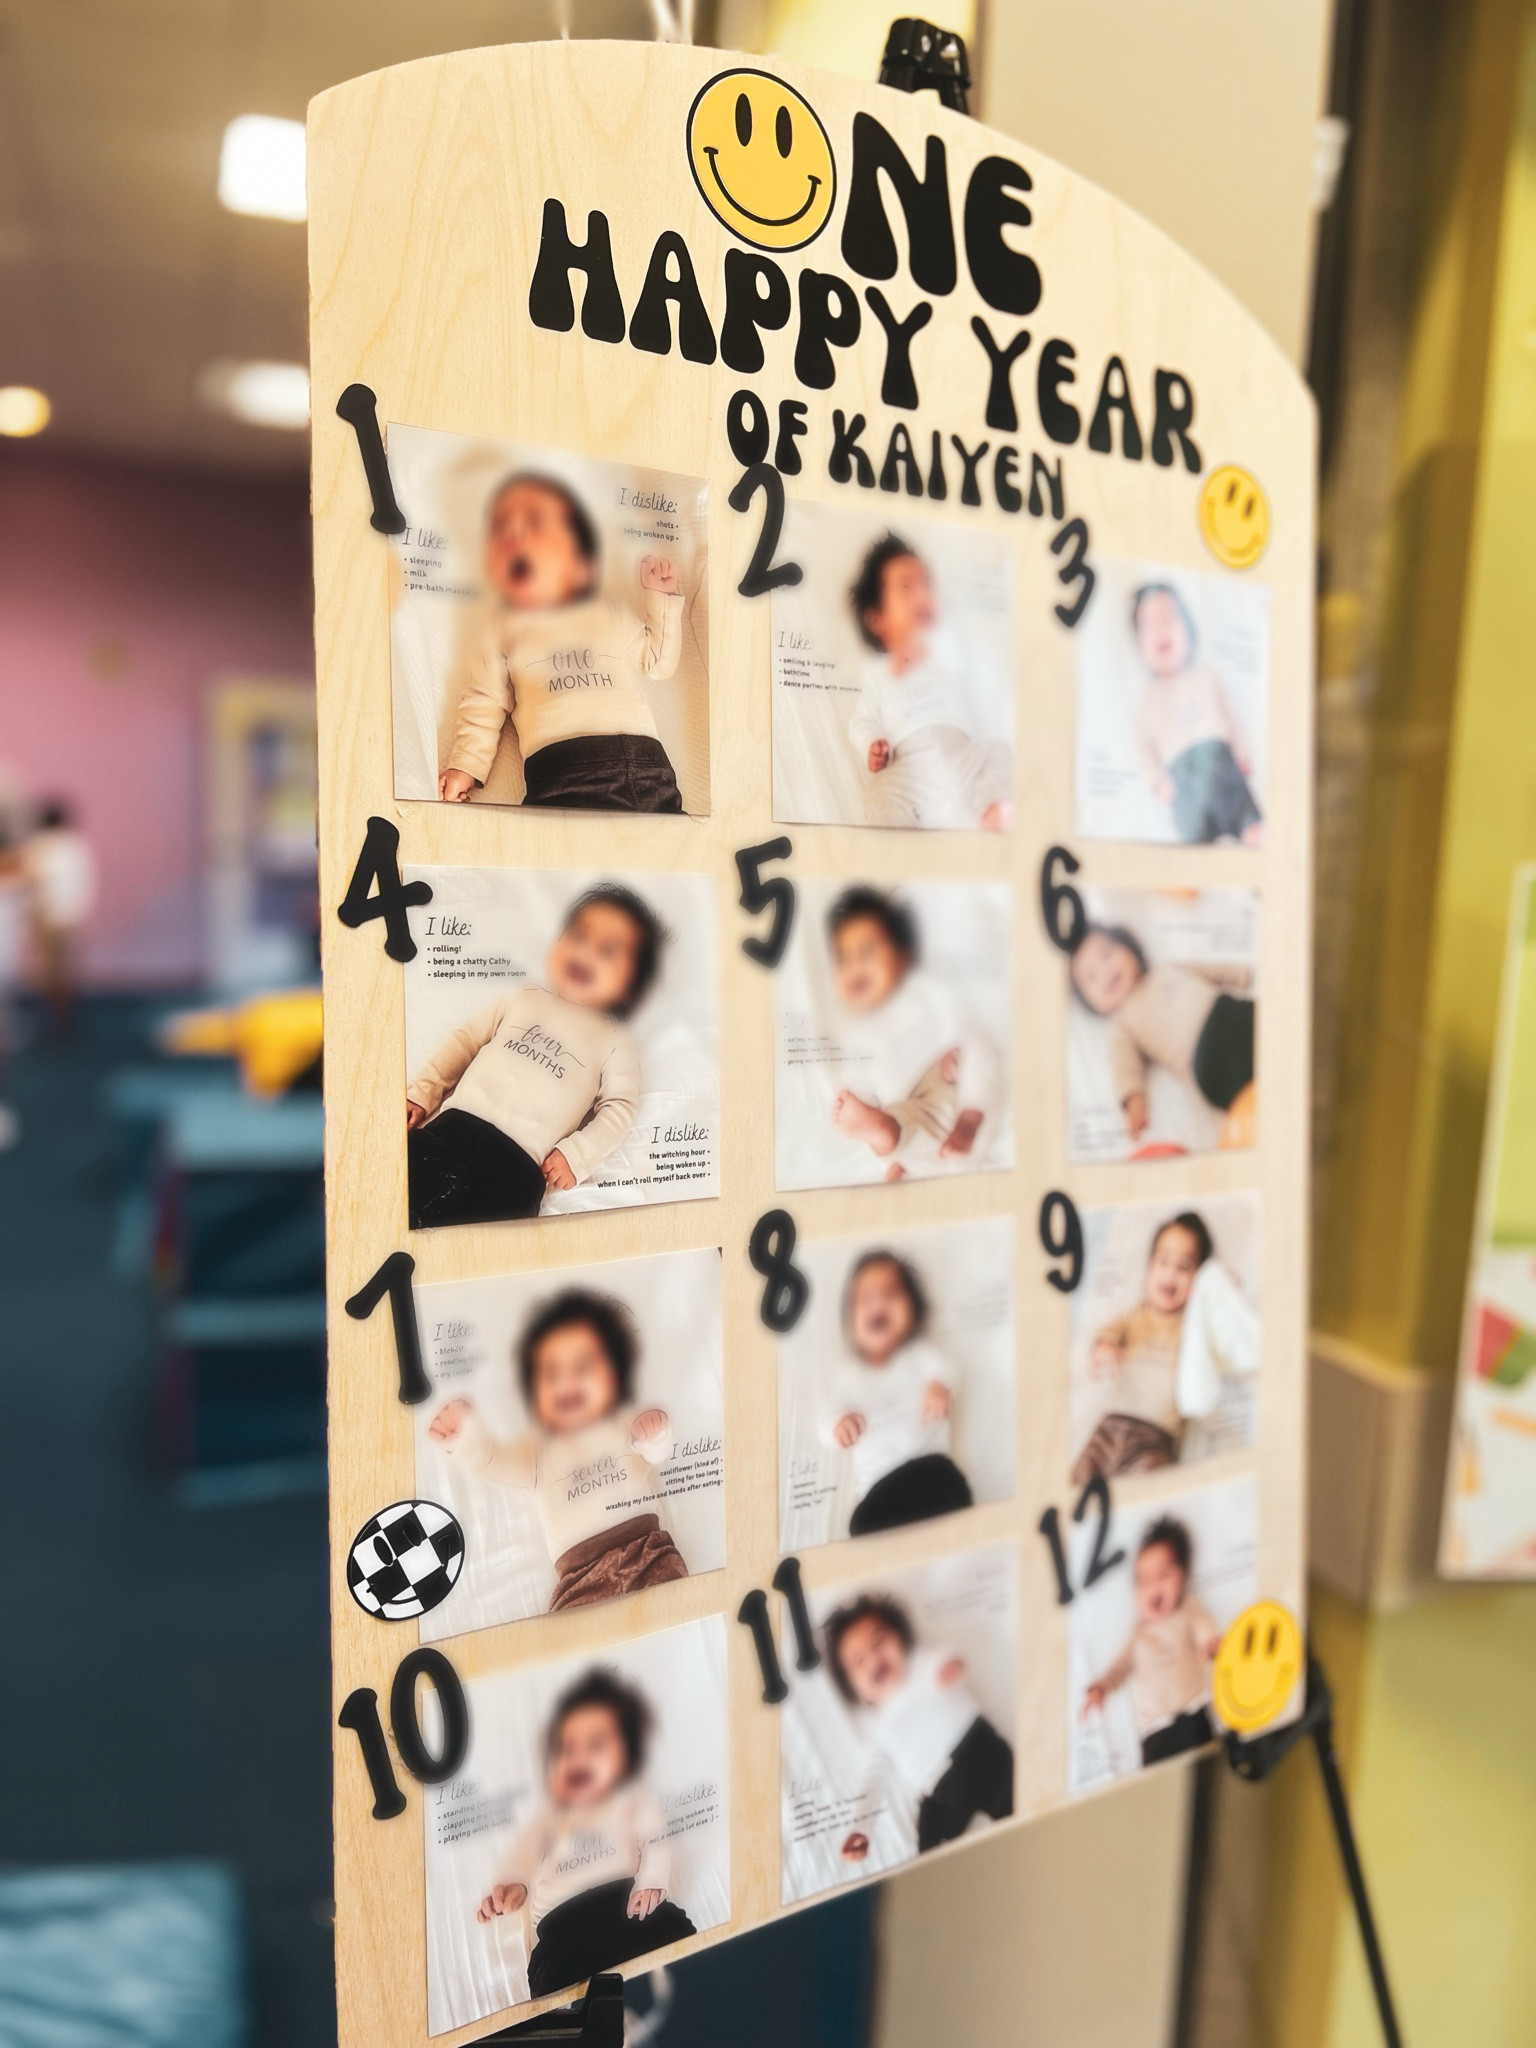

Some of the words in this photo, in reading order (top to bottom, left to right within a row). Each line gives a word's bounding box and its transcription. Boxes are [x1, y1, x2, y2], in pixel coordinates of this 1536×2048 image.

[528, 198, 931, 410] HAPPY
[971, 316, 1201, 473] YEAR
[336, 384, 406, 534] 1
[727, 390, 807, 475] OF
[828, 409, 1063, 519] KAIYEN
[618, 487, 628, 505] I
[632, 491, 678, 514] dislike:
[623, 526, 641, 537] being
[643, 530, 665, 539] woken
[666, 534, 674, 542] up
[656, 520, 674, 529] shots
[728, 463, 803, 597] 2
[402, 527, 412, 545] I
[409, 556, 442, 568] sleeping
[1049, 517, 1095, 628] 3
[410, 583, 444, 592] pre-bath
[778, 631, 786, 648] I
[783, 658, 805, 667] smiling
[549, 673, 613, 692] MONTH
[783, 669, 810, 677] bathtime
[783, 680, 801, 688] dance
[802, 682, 823, 690] parties
[338, 816, 433, 962] 4
[735, 836, 795, 969] 5
[1041, 846, 1086, 954] 6
[425, 917, 437, 936] I
[441, 916, 472, 936] like:
[433, 945, 462, 954] rolling!
[433, 957, 455, 967] being
[463, 958, 487, 966] chatty
[489, 957, 511, 966] Cathy
[433, 970, 466, 979] sleeping
[477, 971, 488, 979] my
[503, 1039, 566, 1079] MONTHS
[651, 1126, 660, 1144] I
[664, 1123, 709, 1143] dislike:
[661, 1150, 689, 1158] witching
[656, 1163, 674, 1171] being
[676, 1161, 697, 1169] woken
[598, 1180, 617, 1188] when
[653, 1174, 675, 1183] myself
[676, 1172, 691, 1180] back
[1040, 1191, 1084, 1292] 9
[749, 1209, 809, 1333] 8
[433, 1323, 443, 1341] I
[670, 1443, 678, 1460] I
[682, 1436, 722, 1457] dislike:
[660, 1464, 693, 1477] cauliflower
[694, 1459, 709, 1469] (kind
[710, 1457, 719, 1465] of)
[568, 1469, 628, 1501] MONTHS
[665, 1476, 685, 1486] sitting
[706, 1469, 719, 1477] long
[606, 1500, 631, 1511] washing
[643, 1494, 655, 1502] face
[656, 1491, 667, 1499] and
[668, 1487, 686, 1496] hands
[702, 1480, 721, 1488] eating
[1040, 1478, 1124, 1605] 12
[738, 1557, 821, 1704] 11
[339, 1648, 469, 1820] 10
[436, 1786, 446, 1805] I
[443, 1805, 475, 1819] standing
[443, 1816, 475, 1831] clapping
[443, 1830, 471, 1845] playing
[473, 1824, 489, 1833] with
